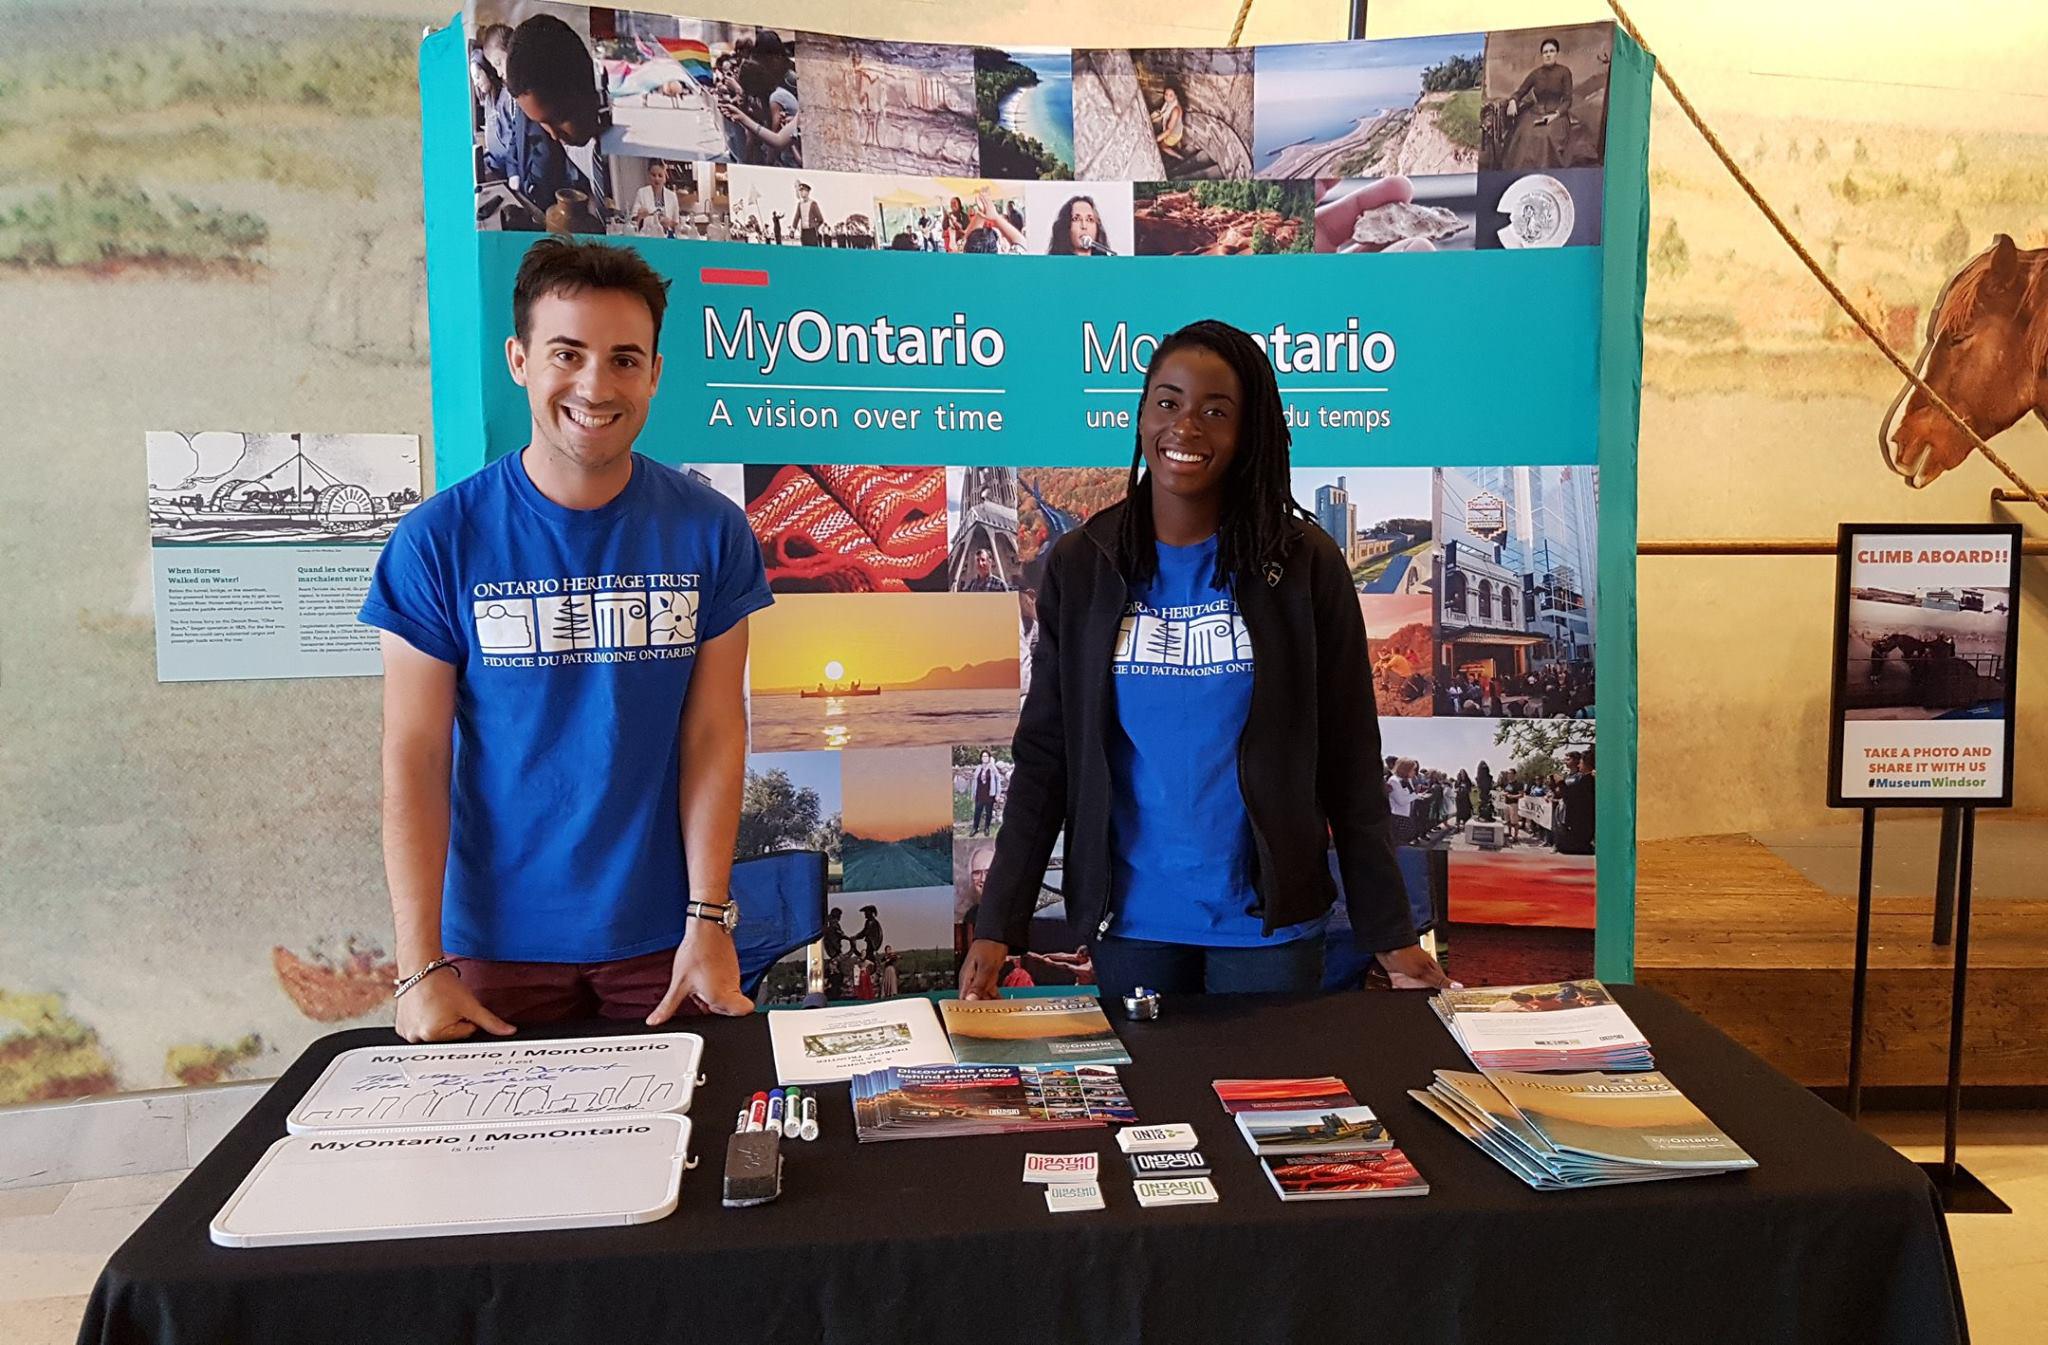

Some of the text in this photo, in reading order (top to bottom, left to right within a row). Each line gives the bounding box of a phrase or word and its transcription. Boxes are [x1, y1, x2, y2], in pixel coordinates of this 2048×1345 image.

[703, 305, 1006, 375] MyOntario
[1082, 317, 1396, 373] Motario
[709, 398, 1004, 431] A vision over time
[1086, 403, 1391, 432] une du temps
[1857, 549, 2009, 564] CLIMB ABOARD!!
[474, 574, 700, 598] ONTARIO HERITAGE TRUST
[1161, 600, 1230, 619] HERITAGE
[483, 645, 697, 668] FIDUCIE DU PATRIMOINE ONTARIEN
[1131, 665, 1150, 675] DU
[1151, 665, 1224, 677] PATRIMOINE
[1864, 747, 1992, 758] TAKE A PHOTO AND
[1868, 762, 1987, 773] SHARE IT WITH US
[1868, 777, 1987, 788] #MuseumWindsor
[1025, 1000, 1096, 1012] Matters
[371, 1051, 503, 1064] MyOntario
[524, 1043, 670, 1057] MonOntario
[897, 1067, 951, 1075] Discover
[978, 1067, 1011, 1075] story
[1586, 1081, 1672, 1094] Matters
[309, 1135, 461, 1152] MyOntario
[484, 1125, 651, 1143] MonOntario
